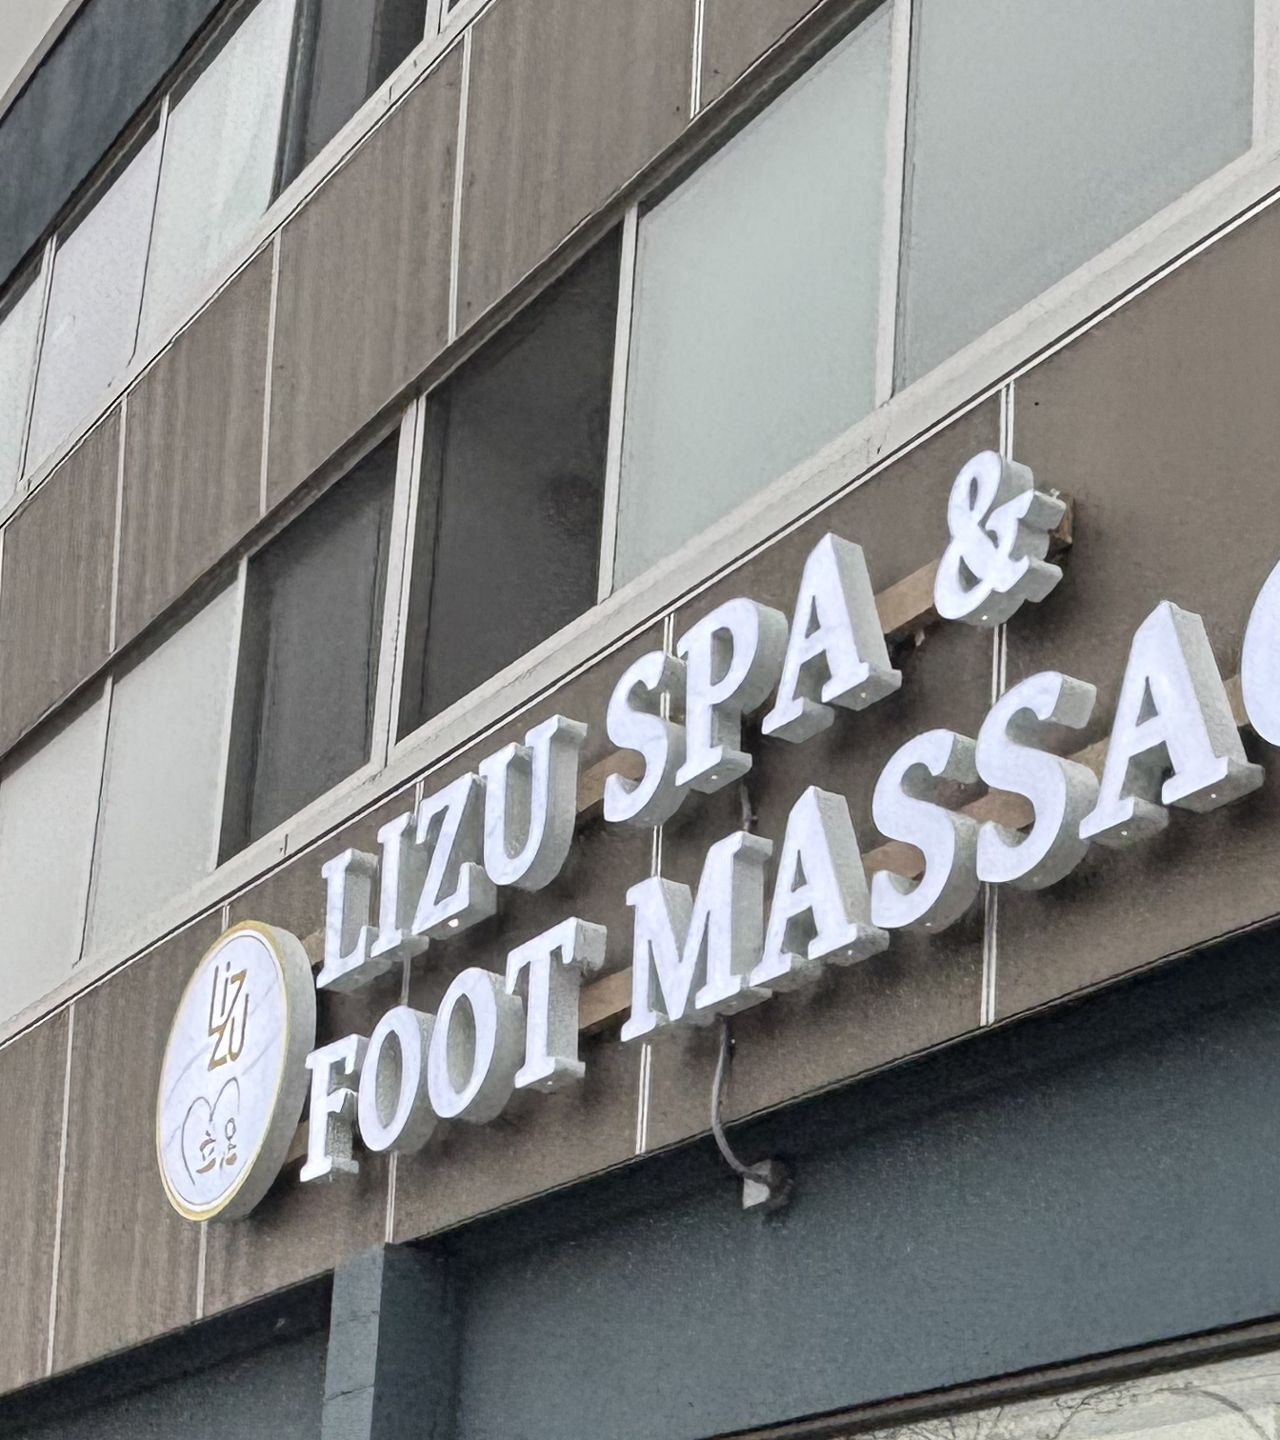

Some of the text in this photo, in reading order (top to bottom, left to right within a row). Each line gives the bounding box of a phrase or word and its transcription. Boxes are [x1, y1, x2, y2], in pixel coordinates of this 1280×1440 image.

[317, 450, 1066, 990] LIZU SPA &
[300, 916, 607, 1183] FOOT
